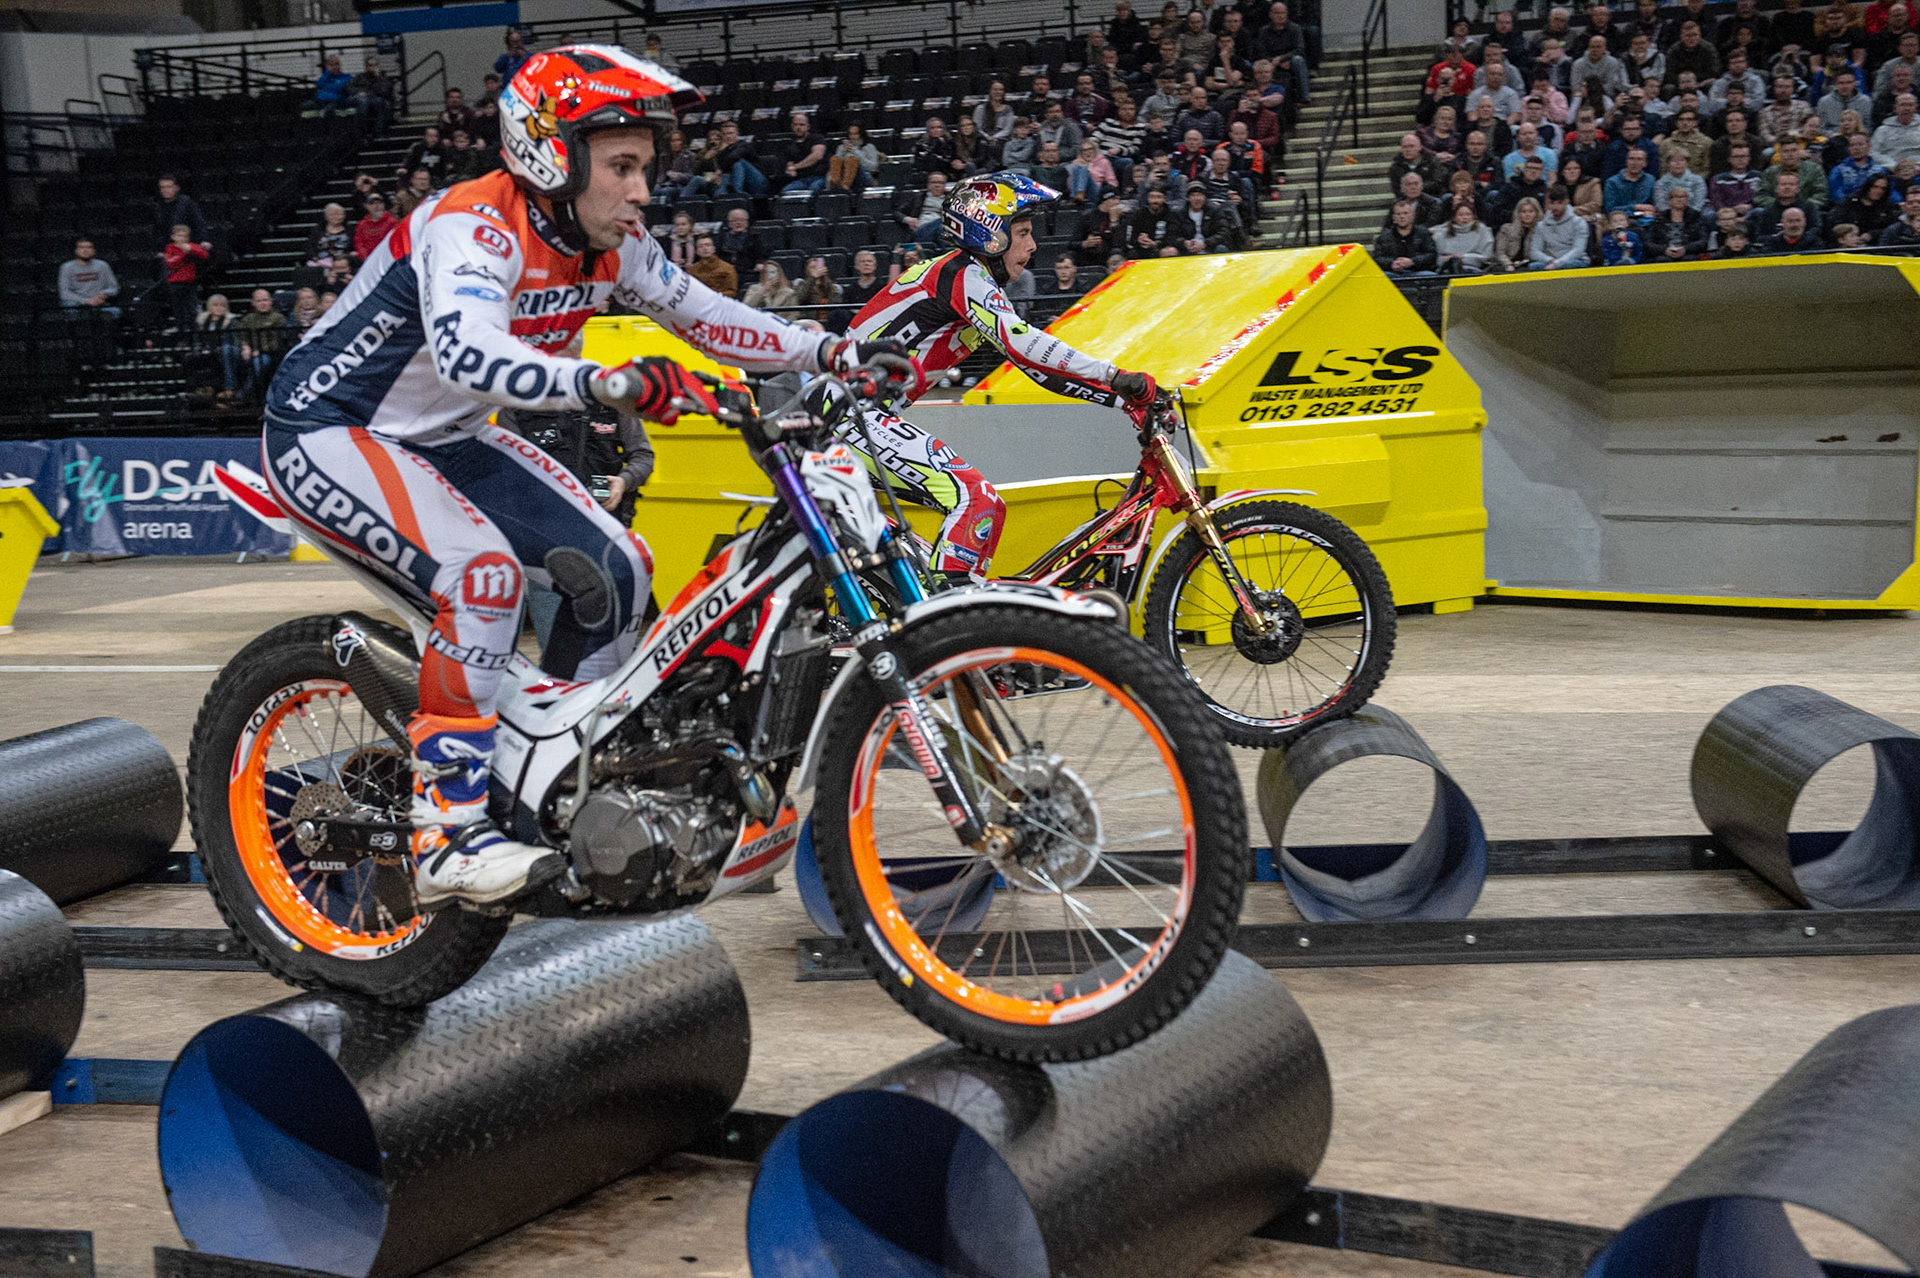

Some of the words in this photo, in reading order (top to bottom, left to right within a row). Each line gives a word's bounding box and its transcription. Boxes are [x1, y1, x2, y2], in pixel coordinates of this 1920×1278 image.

[950, 198, 976, 219] Red
[973, 207, 1004, 232] Bull
[515, 285, 595, 316] REPSOL
[286, 310, 407, 411] HONDA
[434, 310, 567, 400] REPSOL
[1257, 345, 1440, 387] LSS
[1063, 381, 1110, 404] TRS
[1240, 404, 1297, 422] 0113
[1303, 401, 1355, 418] 282
[1357, 398, 1419, 414] 4531
[1250, 389, 1298, 403] WASTE
[1300, 384, 1395, 400] MANAGEMENT
[1399, 383, 1424, 395] LTD
[497, 430, 595, 512] HONDA
[123, 522, 193, 539] arena
[276, 445, 418, 582] REPSOL
[653, 586, 738, 673] REPSOL
[428, 628, 514, 670] hebo
[308, 860, 348, 871] GALFER
